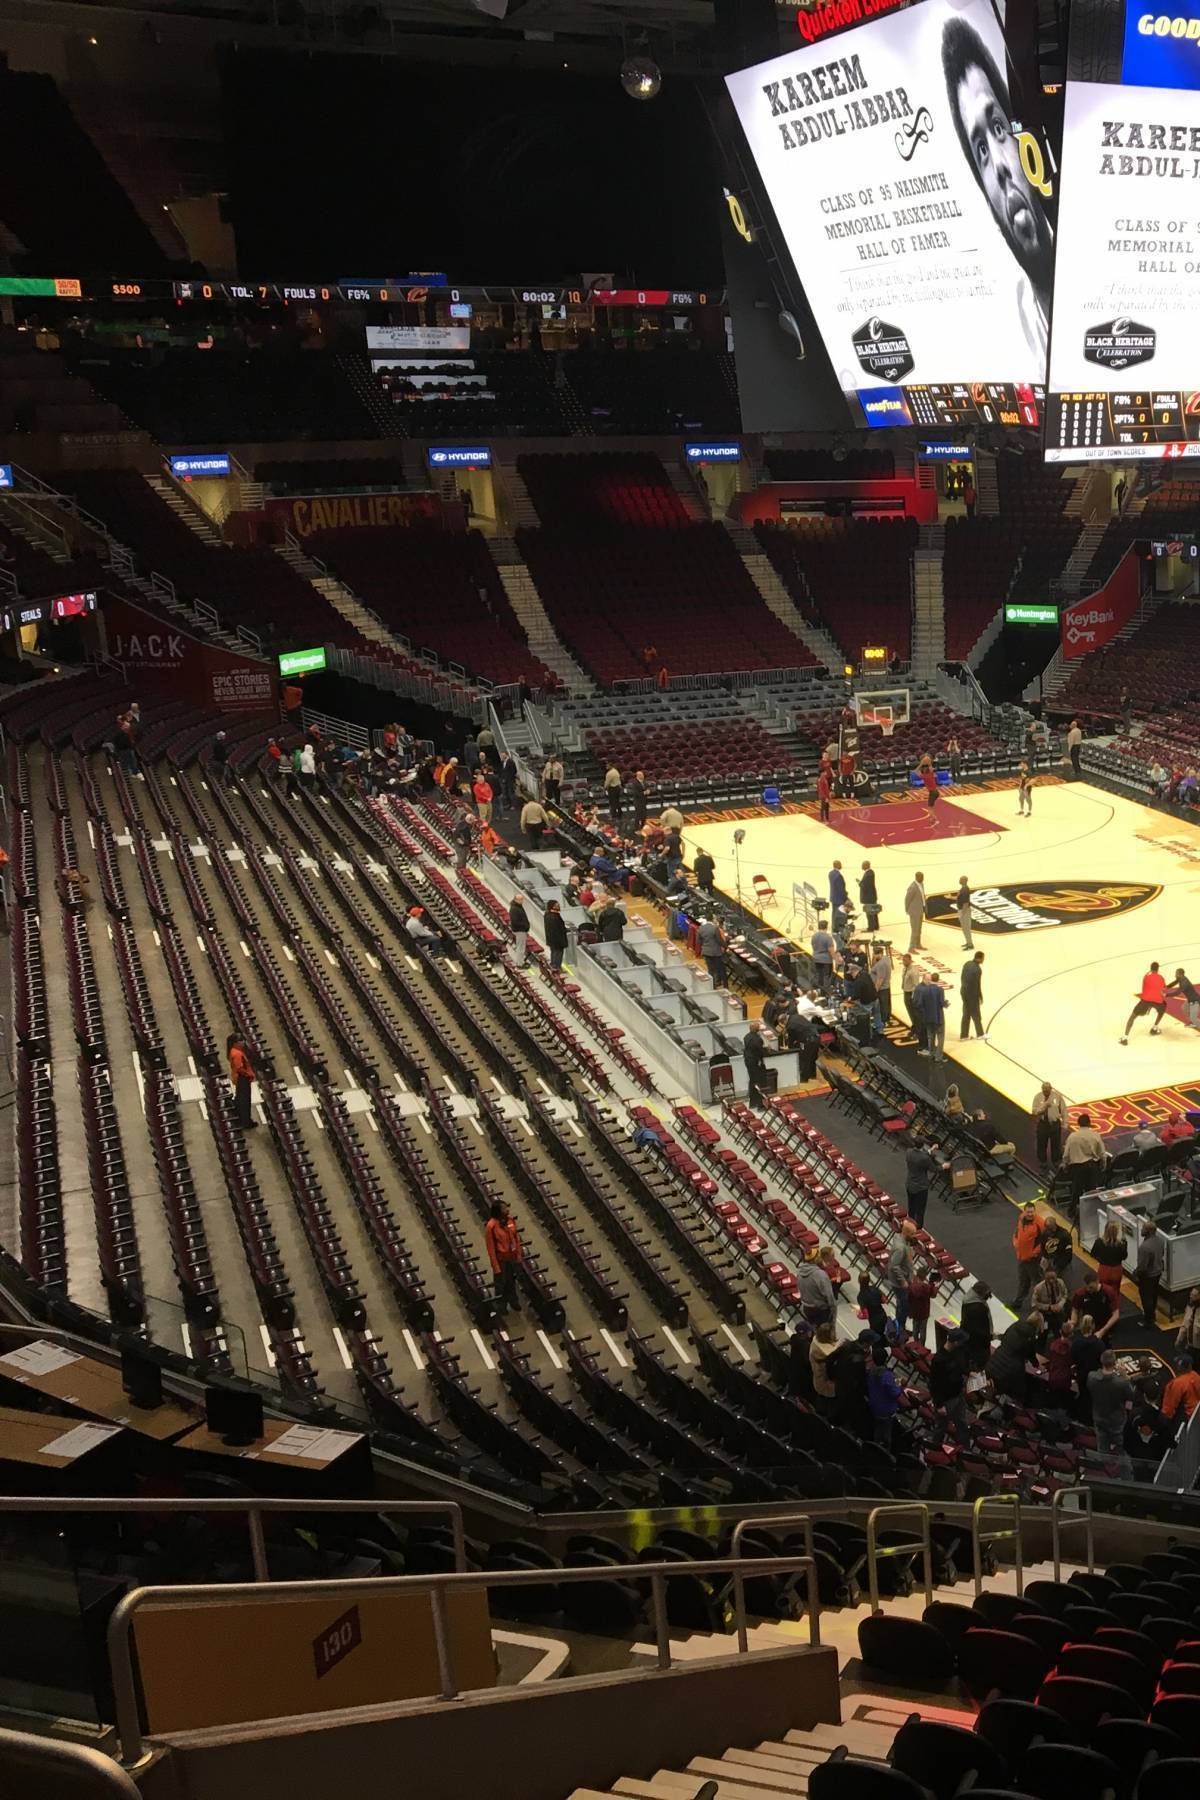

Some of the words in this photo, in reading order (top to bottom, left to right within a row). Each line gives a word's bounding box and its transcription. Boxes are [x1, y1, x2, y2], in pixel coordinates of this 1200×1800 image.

[797, 0, 862, 42] Quicken
[763, 54, 868, 117] KAREEM
[779, 86, 914, 150] ABDUL-JABBAR
[820, 193, 856, 214] CLASS
[858, 188, 874, 206] OF
[879, 185, 893, 201] 95
[894, 172, 949, 198] NAISMITH
[824, 213, 891, 240] MEMORIAL
[892, 200, 962, 227] BASKETBALL
[1114, 219, 1160, 232] CLASS
[1167, 221, 1188, 233] OF
[856, 240, 889, 261] HALL
[891, 237, 907, 255] OF
[910, 231, 951, 252] FAMER
[1108, 240, 1194, 254] MEMORIAL
[1138, 260, 1177, 273] HALL
[230, 287, 253, 298] TOL:
[259, 287, 267, 298] 7
[284, 288, 316, 299] FOULS
[321, 288, 329, 300] 0
[348, 289, 370, 300] FG%
[380, 290, 388, 301] 0
[451, 290, 460, 302] 0
[522, 291, 556, 302] 80:02
[637, 292, 646, 304] 0
[672, 293, 692, 304] FG%
[700, 294, 707, 304] 0
[856, 343, 878, 356] BLACK
[878, 340, 908, 353] HERITAGE
[1086, 337, 1113, 346] BLACK
[1115, 337, 1154, 346] HERITAGE
[1162, 412, 1169, 424] 0
[1142, 431, 1149, 442] 7
[448, 452, 488, 462] HYUNDAI
[703, 448, 738, 456] HYUNDAI
[934, 446, 969, 454] HYUNDAI
[189, 460, 228, 471] HYUNDAI
[20, 608, 42, 624] STEALS
[1066, 608, 1115, 627] KeyBank
[212, 675, 232, 687] EPIC
[234, 673, 270, 686] STORIES
[322, 1620, 354, 1662] 130
